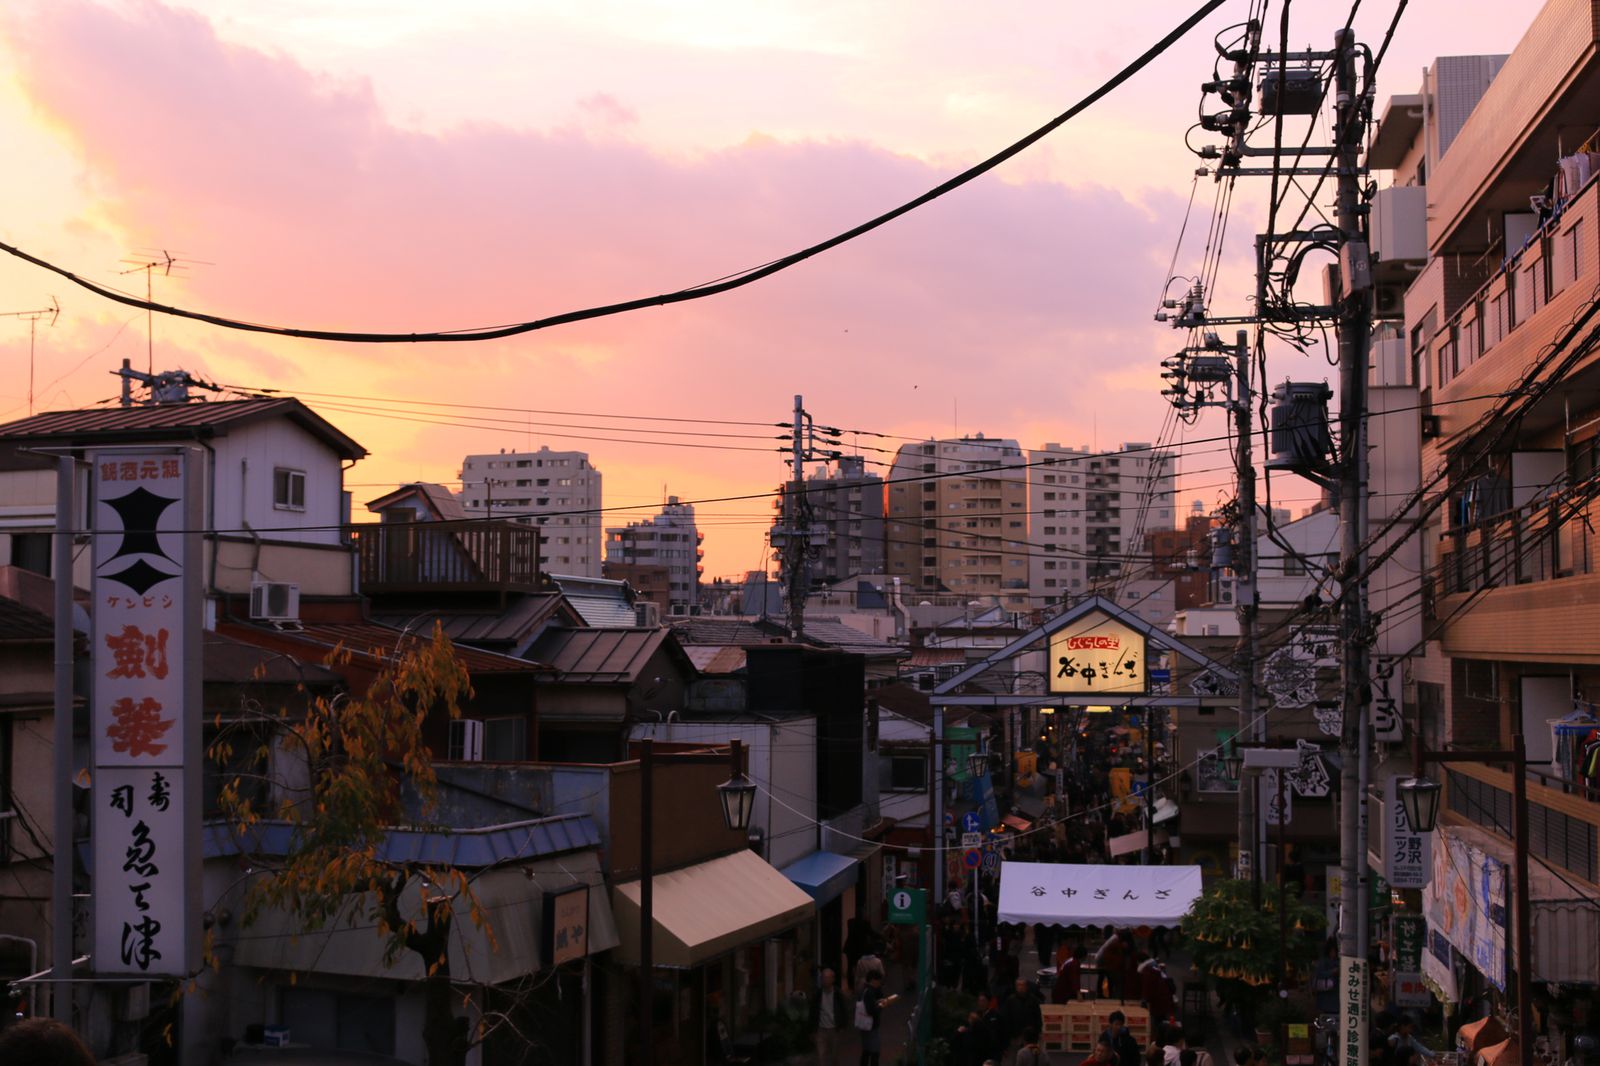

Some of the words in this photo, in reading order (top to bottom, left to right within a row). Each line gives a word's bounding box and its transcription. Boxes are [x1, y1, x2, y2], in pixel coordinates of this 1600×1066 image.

[107, 594, 173, 609] ケンビシ
[1057, 647, 1138, 686] 谷中ぎんざ
[1376, 656, 1396, 733] リーマン
[1394, 803, 1407, 863] クリニック
[1408, 831, 1422, 864] 野沢
[1030, 886, 1172, 901] 谷中ぎんざ
